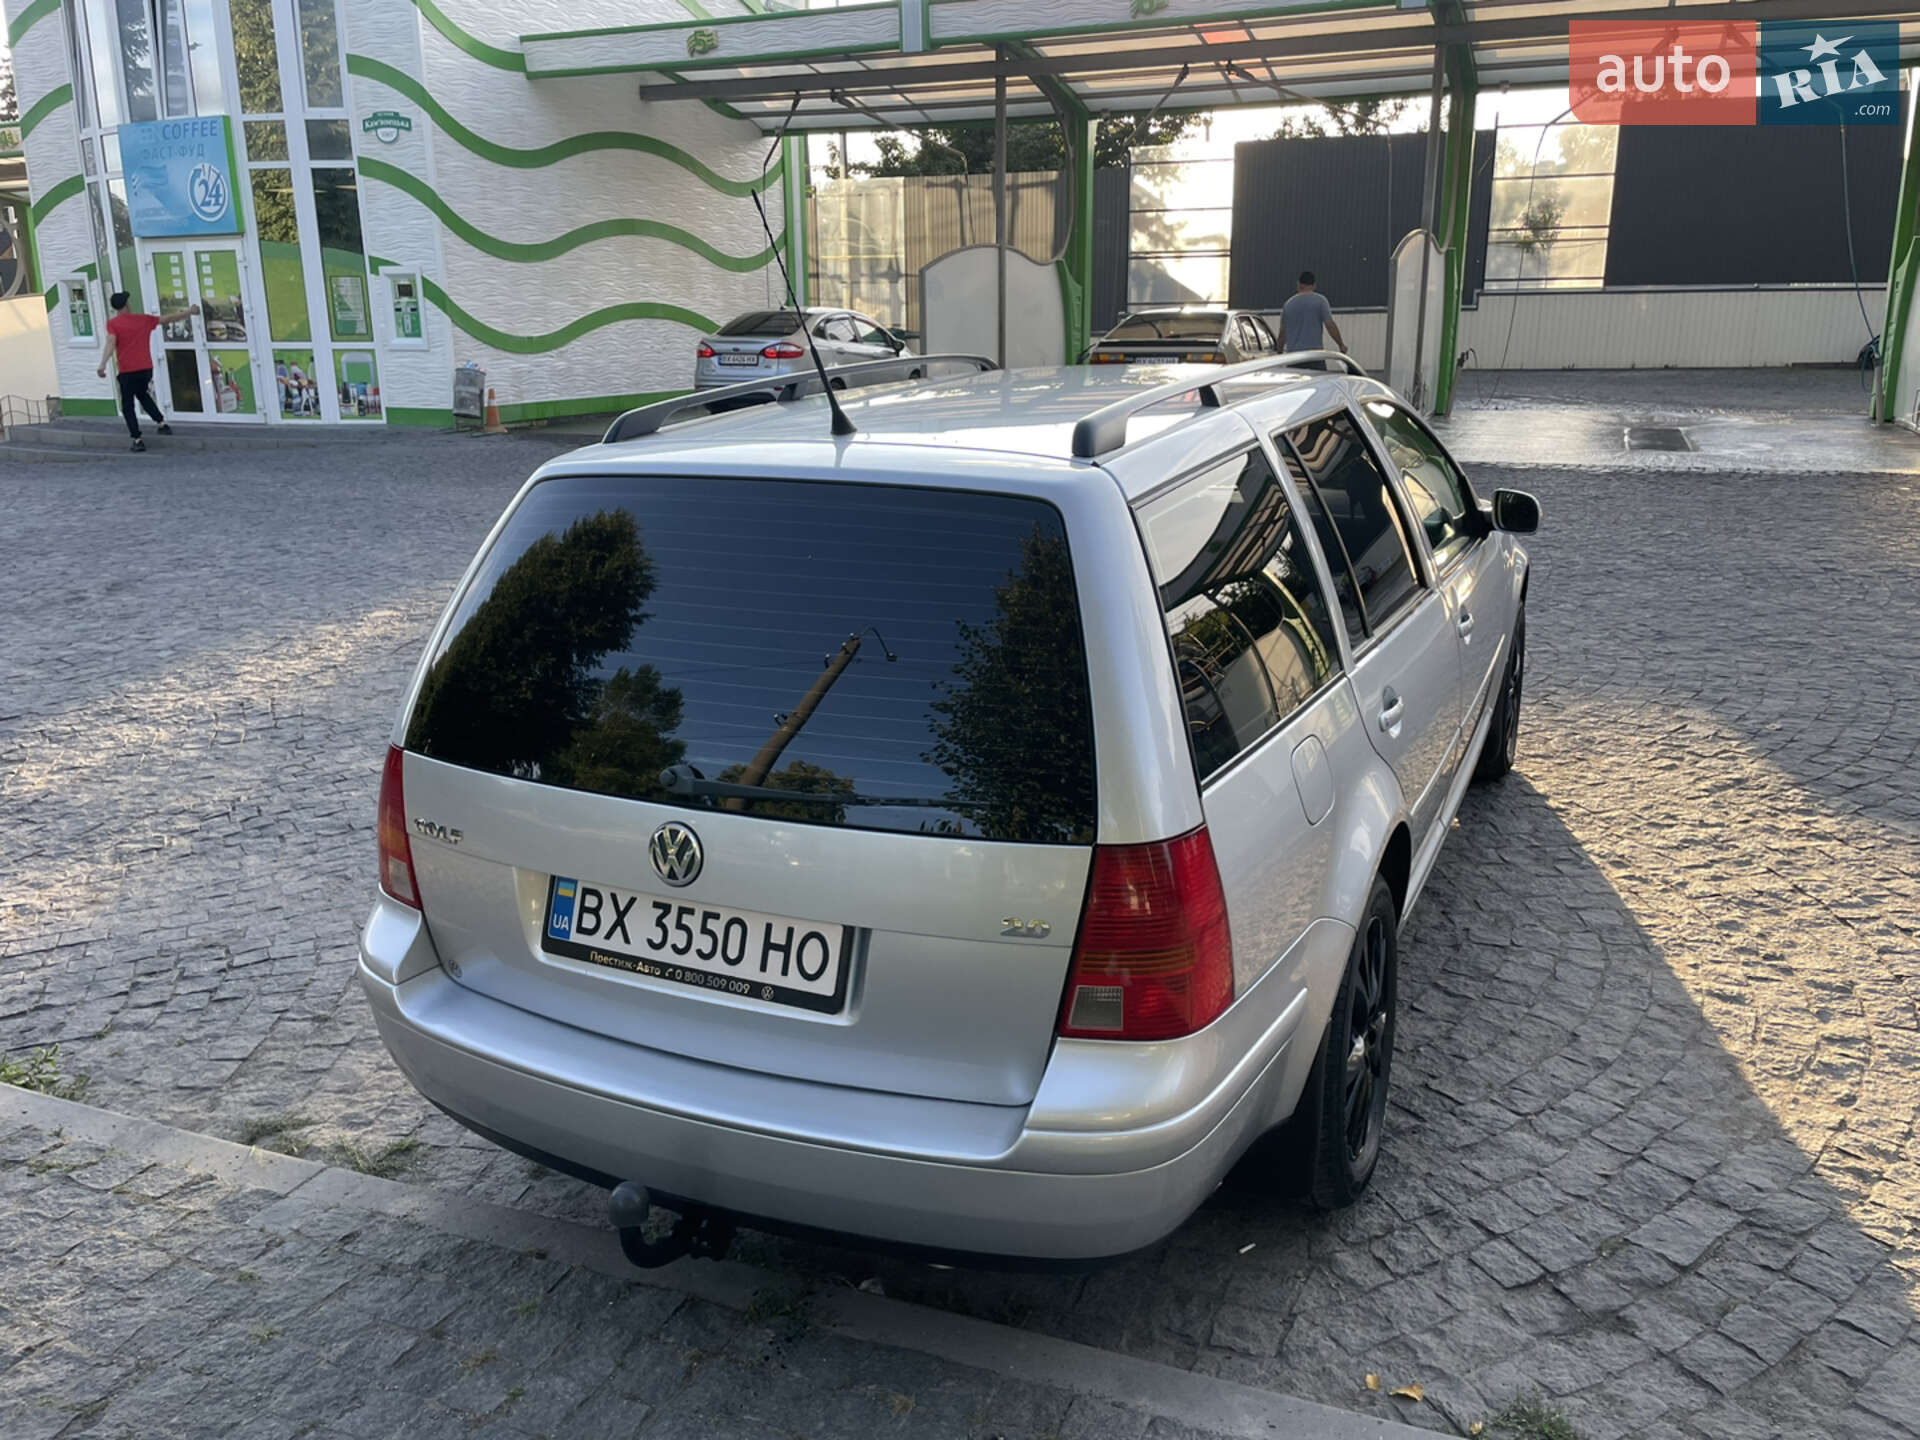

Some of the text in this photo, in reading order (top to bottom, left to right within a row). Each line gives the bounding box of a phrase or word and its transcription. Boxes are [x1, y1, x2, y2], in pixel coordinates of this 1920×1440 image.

[162, 120, 218, 140] COFFEE
[198, 178, 223, 207] 24
[552, 914, 569, 931] UA
[575, 887, 830, 981] BX 3550 HO
[675, 969, 683, 980] 0
[684, 970, 704, 985] 800
[707, 975, 727, 989] 509
[729, 980, 750, 994] 009
